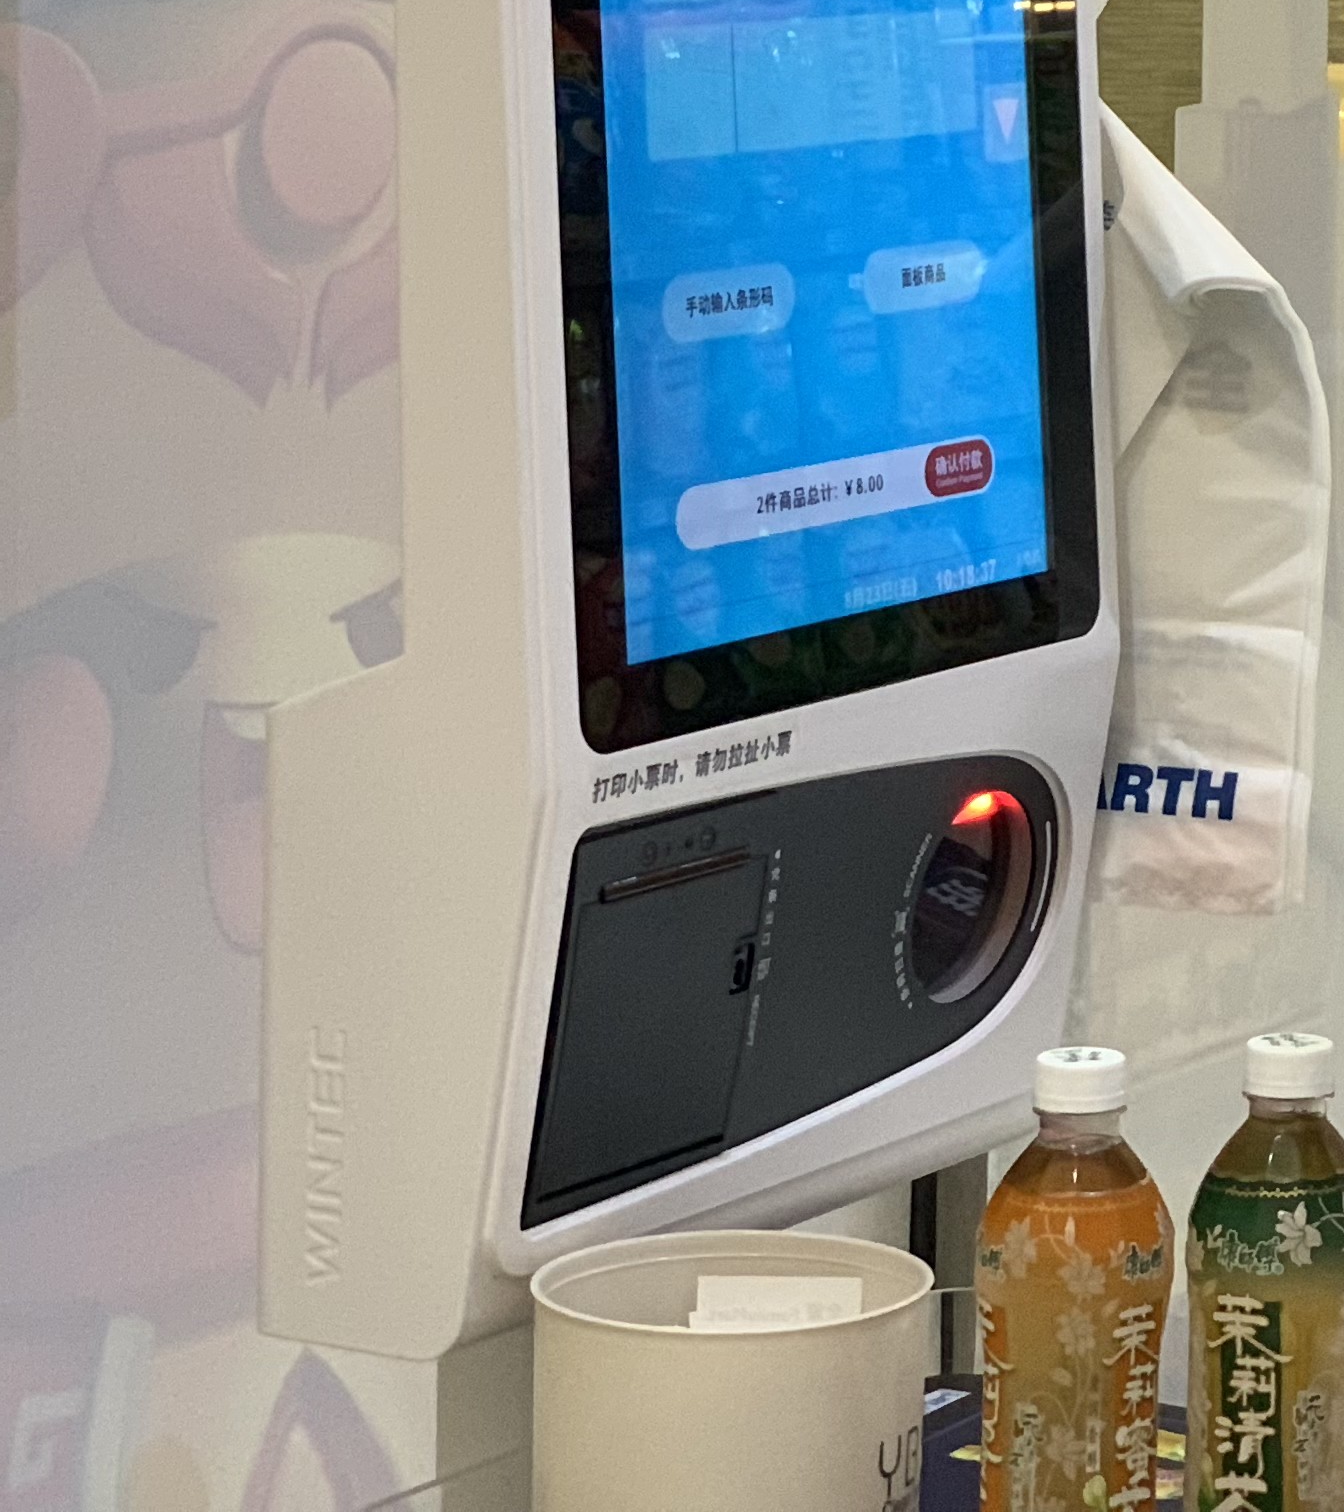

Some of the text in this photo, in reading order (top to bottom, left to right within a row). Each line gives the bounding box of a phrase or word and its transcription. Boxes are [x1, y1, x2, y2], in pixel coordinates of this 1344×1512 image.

[685, 285, 774, 319] 手动输入条形码
[934, 449, 984, 477] 确认付款
[1097, 762, 1239, 821] RTH
[304, 1024, 347, 1286] WINTEC
[1102, 1304, 1160, 1512] 茉莉蜜
